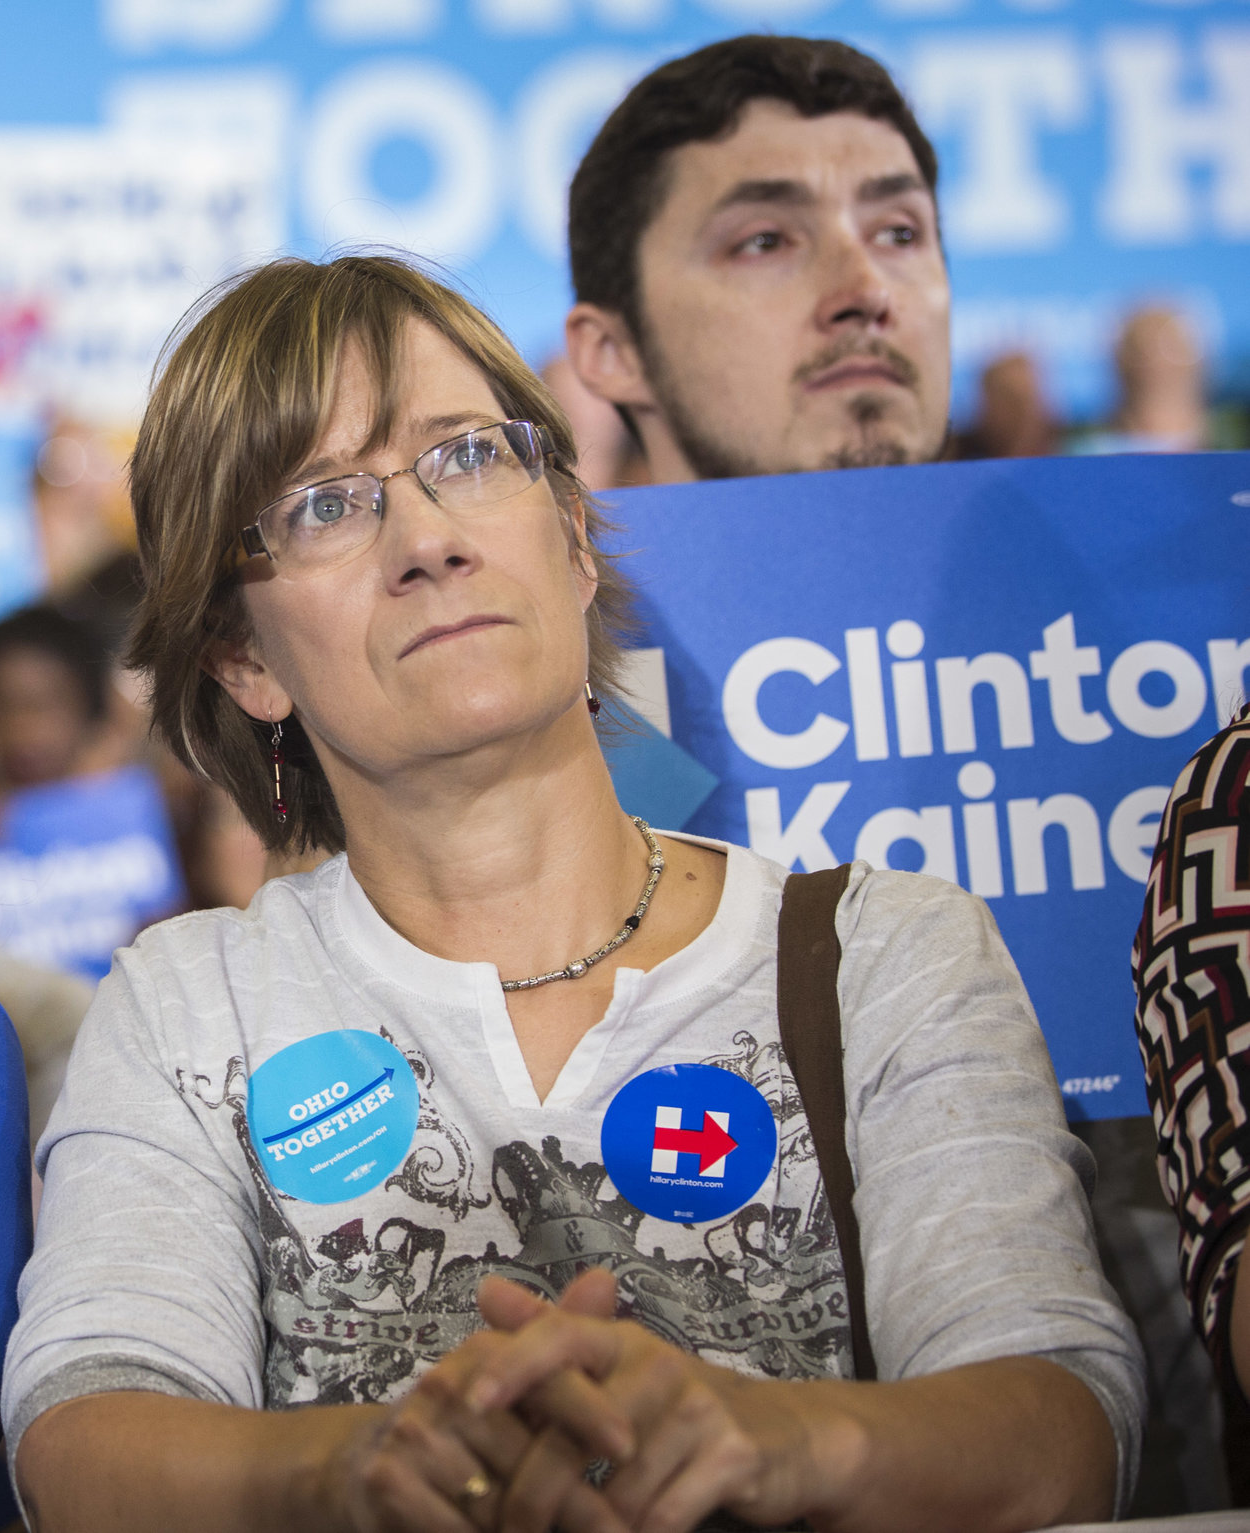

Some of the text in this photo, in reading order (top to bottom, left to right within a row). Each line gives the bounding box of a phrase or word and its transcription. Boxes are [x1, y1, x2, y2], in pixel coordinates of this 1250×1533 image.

[288, 1081, 350, 1121] OHIO
[266, 1084, 396, 1162] TOGETHER
[309, 1125, 388, 1174] hillaryclinton.com/OH
[649, 1175, 724, 1189] hillaryclinton.com
[292, 1312, 440, 1346] strive
